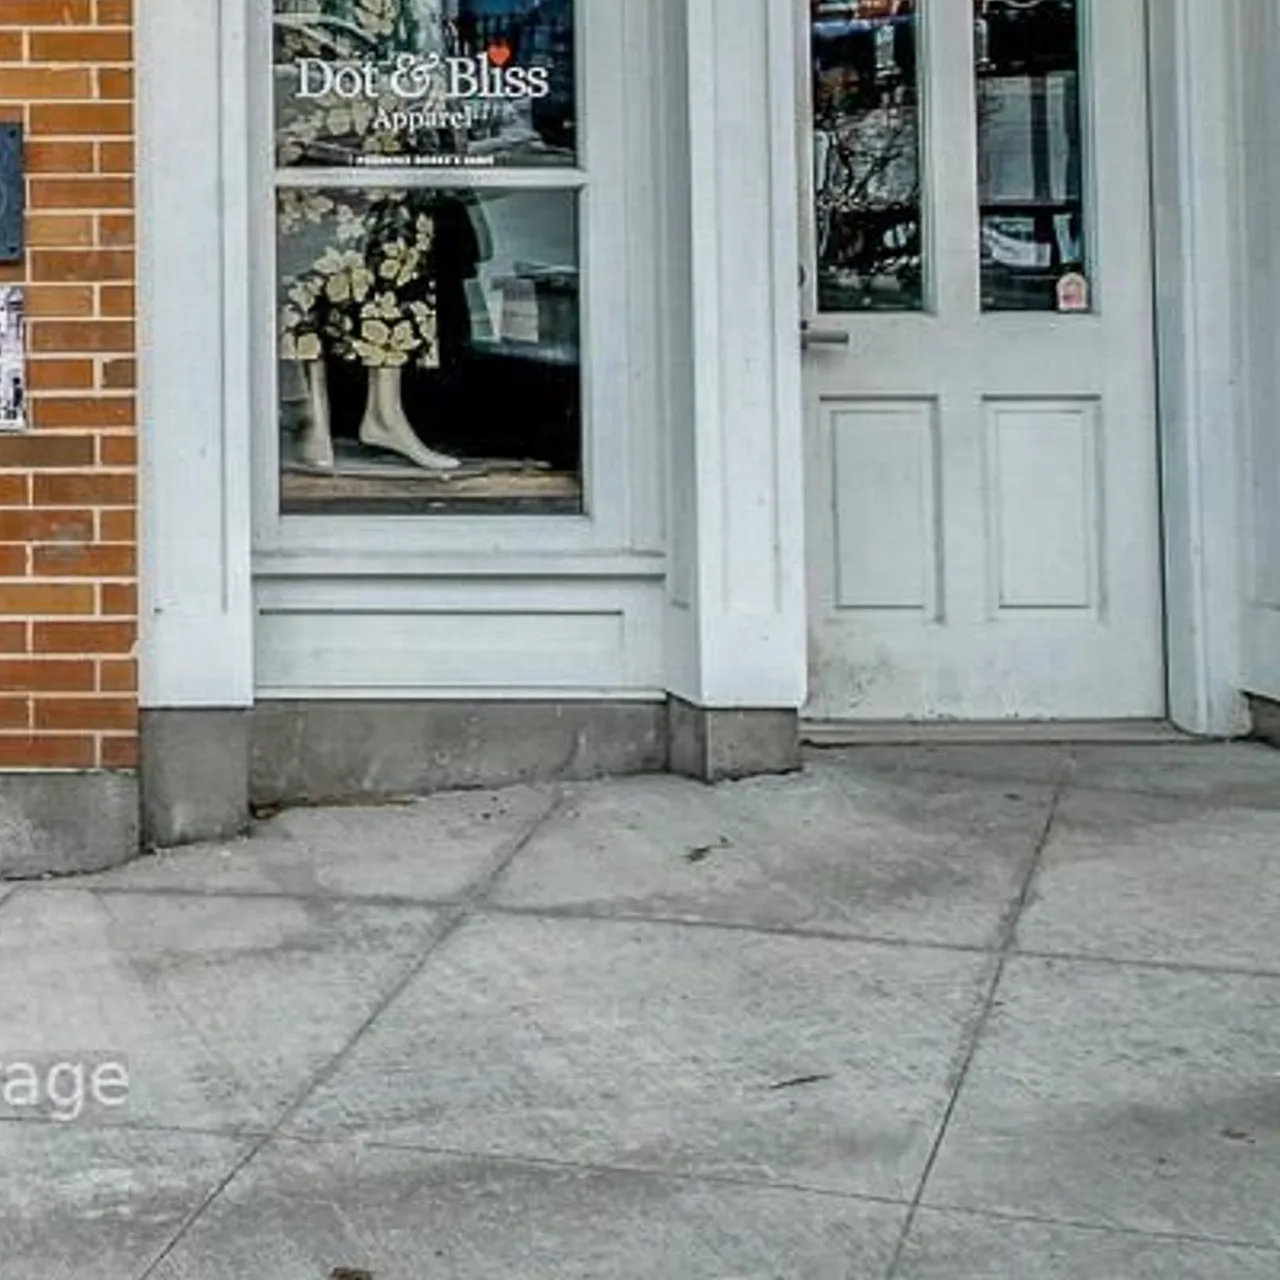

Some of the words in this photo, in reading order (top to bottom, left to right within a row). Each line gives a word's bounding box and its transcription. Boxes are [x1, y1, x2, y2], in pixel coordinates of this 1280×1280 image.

[295, 56, 379, 98] Dot
[391, 52, 438, 98] &
[446, 43, 550, 98] Bliss
[373, 108, 473, 130] Apparel
